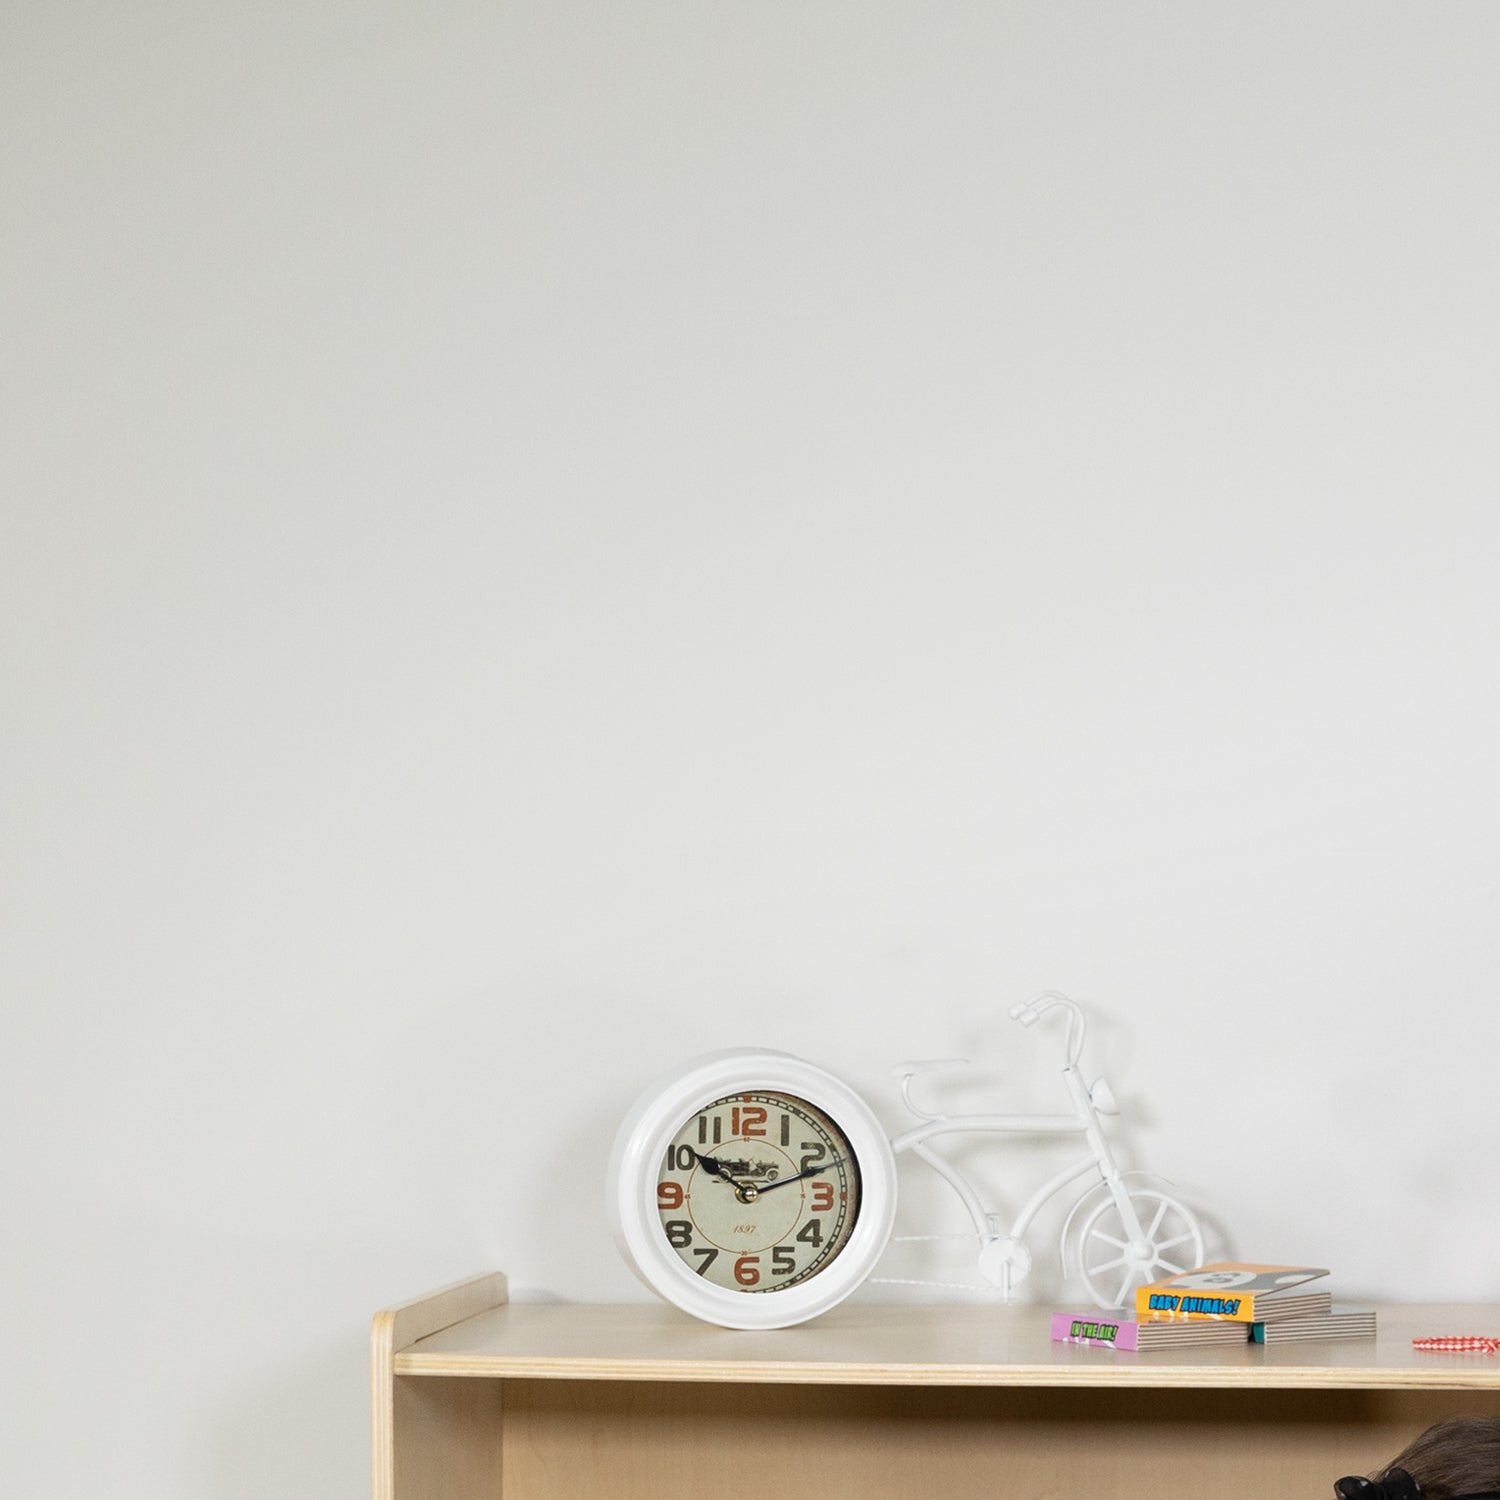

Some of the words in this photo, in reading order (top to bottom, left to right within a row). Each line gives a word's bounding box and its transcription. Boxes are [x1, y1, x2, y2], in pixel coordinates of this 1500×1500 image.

[698, 1116, 721, 1144] 11
[732, 1107, 767, 1135] 12
[780, 1115, 789, 1146] 1
[667, 1144, 696, 1171] 10
[800, 1142, 826, 1173] 2
[657, 1182, 683, 1210] 9
[811, 1182, 834, 1211] 3
[665, 1220, 692, 1248] 8
[732, 1223, 757, 1234] 1897
[796, 1219, 823, 1248] 4
[693, 1249, 719, 1276] 7
[734, 1257, 760, 1285] 6
[772, 1247, 795, 1275] 5
[1149, 1294, 1180, 1311] BABY
[1179, 1295, 1241, 1314] ANIMALS!
[1070, 1320, 1081, 1336] IN
[1082, 1322, 1098, 1340] THE
[1098, 1324, 1119, 1342] AIR!
